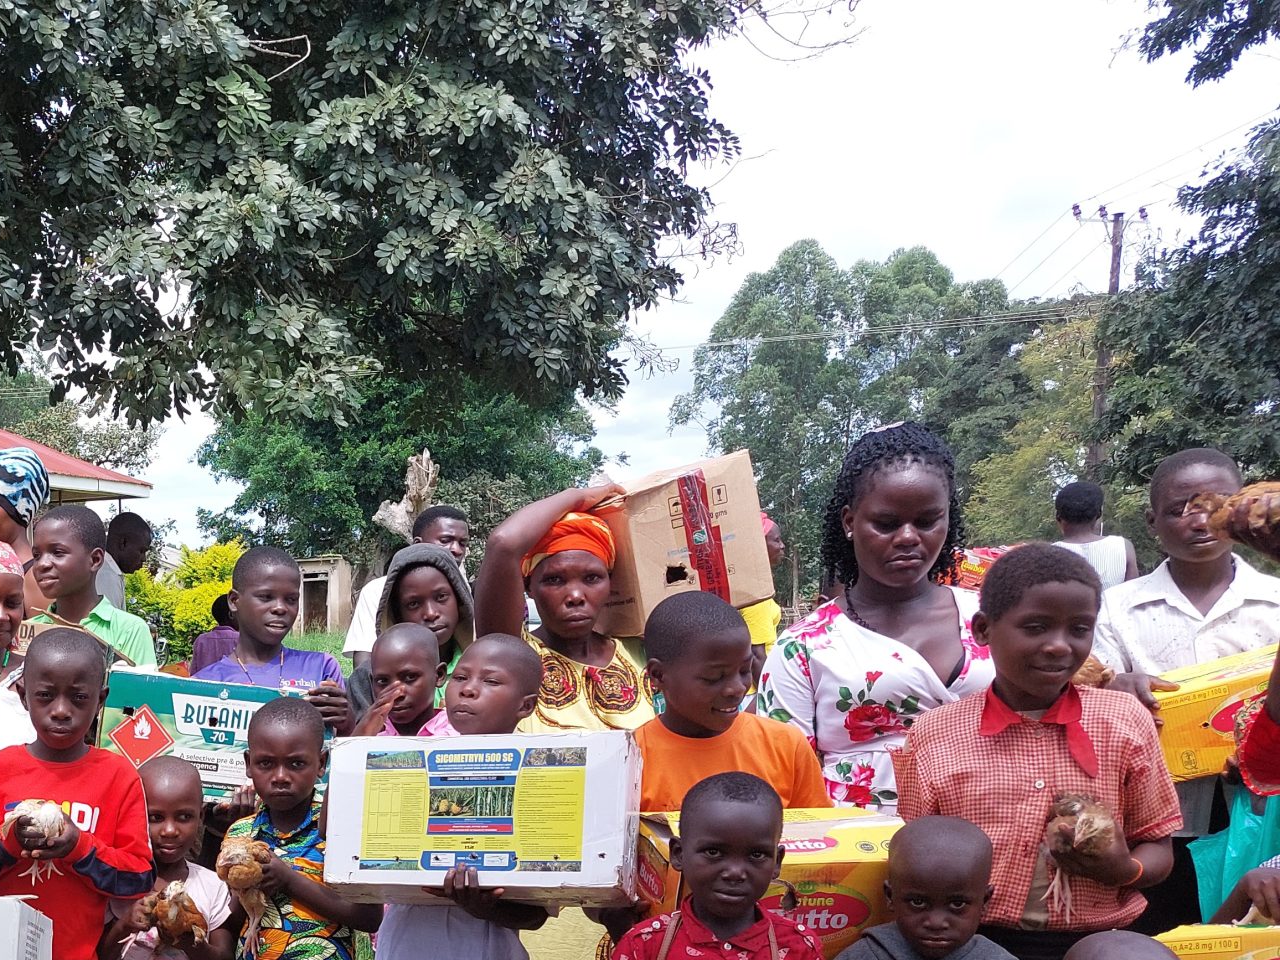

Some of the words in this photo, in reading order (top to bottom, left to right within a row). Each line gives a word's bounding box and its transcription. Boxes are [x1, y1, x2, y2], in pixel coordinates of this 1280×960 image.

[1161, 698, 1178, 708] tamin
[181, 703, 256, 730] BUTANI
[186, 753, 215, 762] selective
[485, 753, 502, 763] 500
[503, 752, 514, 762] SC
[779, 841, 826, 849] utto
[1179, 941, 1200, 950] A=2.8
[1202, 942, 1212, 951] mg
[1218, 940, 1232, 949] 100
[1234, 941, 1239, 949] g
